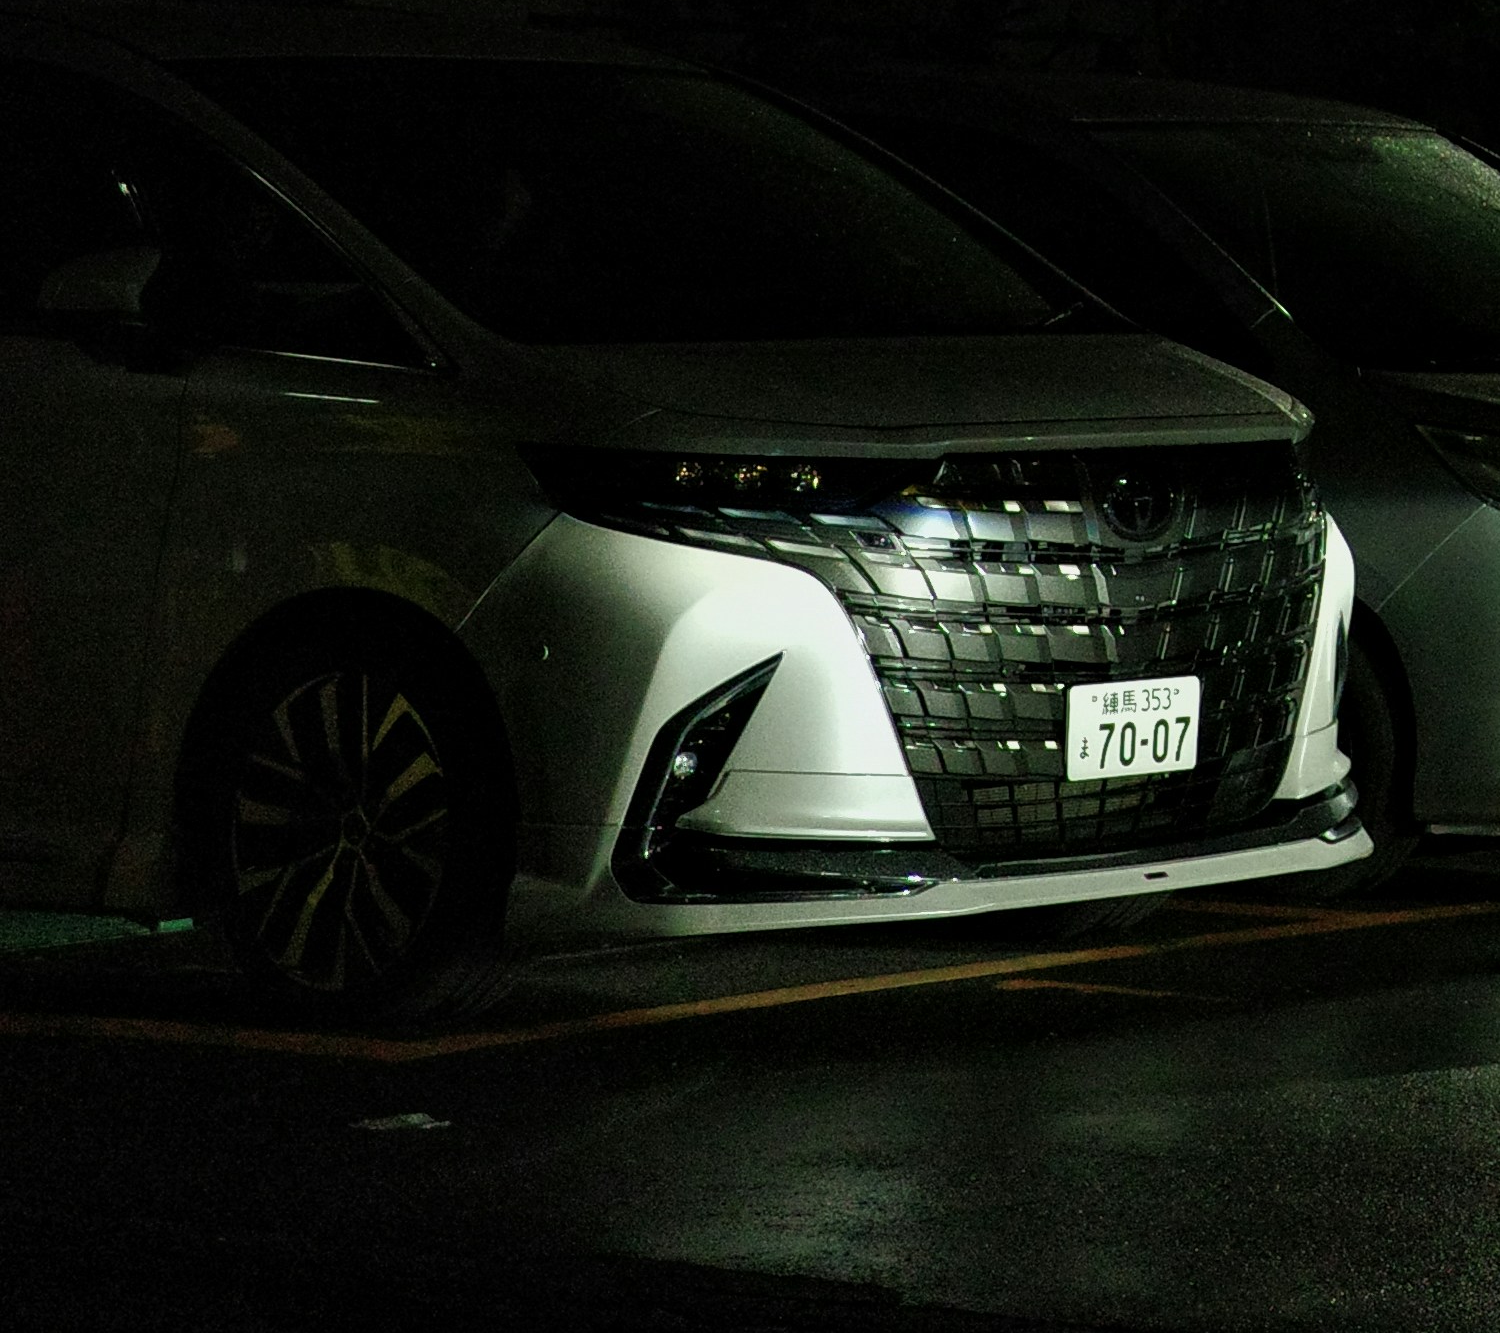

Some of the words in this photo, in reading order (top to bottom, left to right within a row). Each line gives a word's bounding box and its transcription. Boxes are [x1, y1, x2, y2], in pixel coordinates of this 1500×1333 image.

[1102, 690, 1137, 715] 練馬
[1141, 687, 1172, 712] 353
[1079, 736, 1090, 760] ま
[1099, 716, 1191, 770] 70-07
